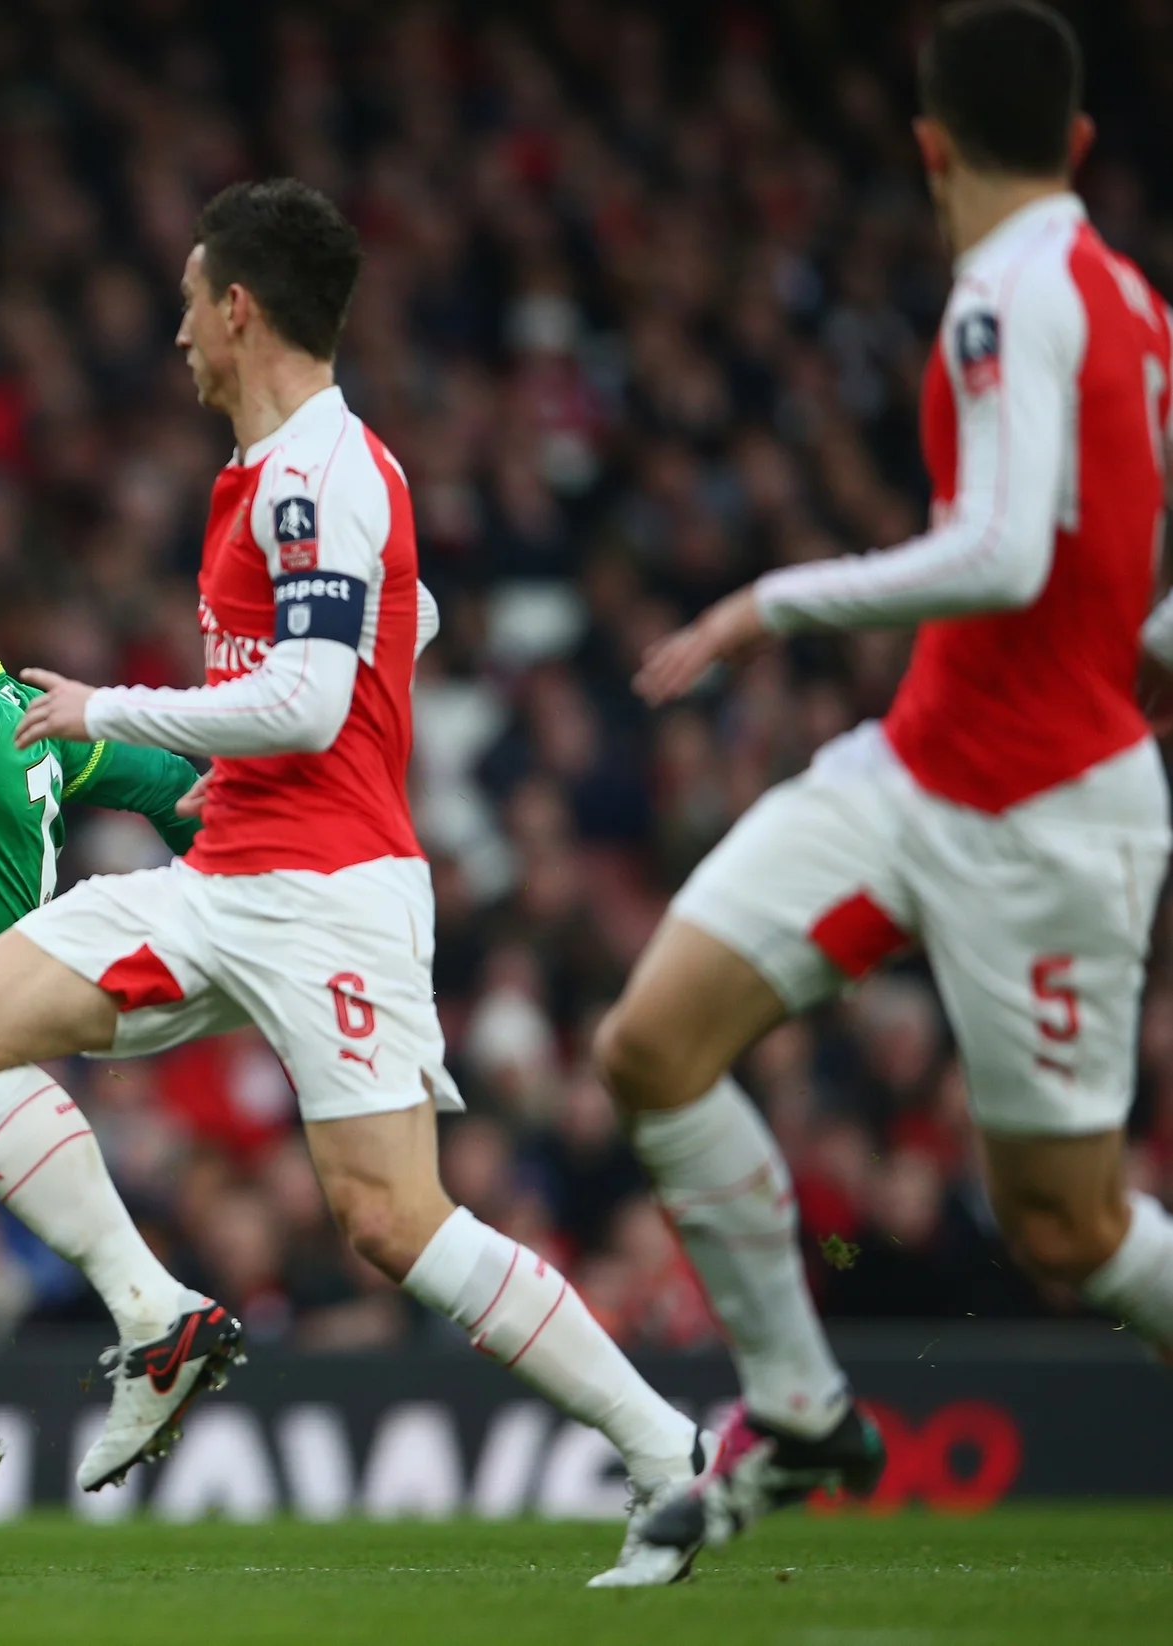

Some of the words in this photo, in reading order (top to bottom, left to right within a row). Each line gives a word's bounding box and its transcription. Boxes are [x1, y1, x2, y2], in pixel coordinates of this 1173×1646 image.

[275, 578, 350, 602] espect
[327, 971, 375, 1039] 6
[1030, 952, 1080, 1042] 5
